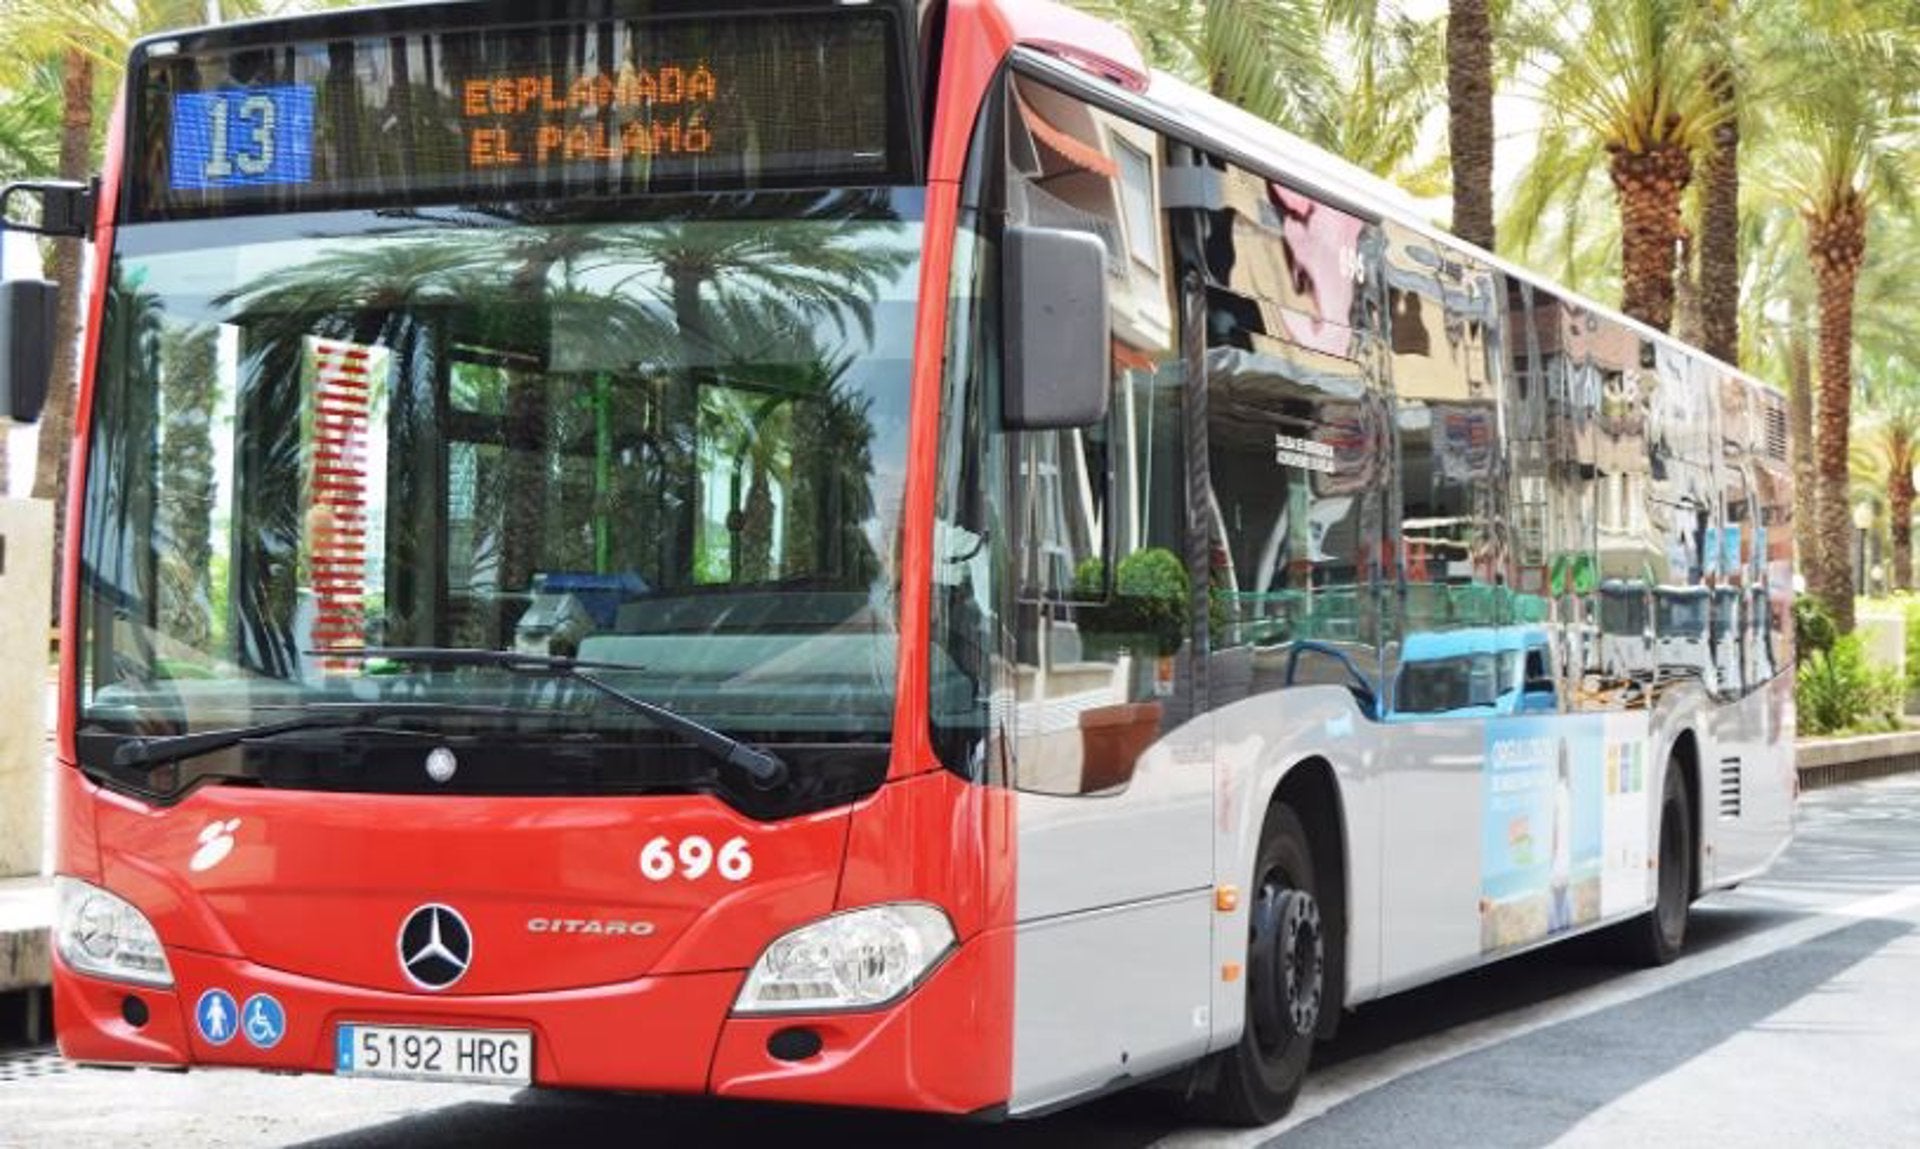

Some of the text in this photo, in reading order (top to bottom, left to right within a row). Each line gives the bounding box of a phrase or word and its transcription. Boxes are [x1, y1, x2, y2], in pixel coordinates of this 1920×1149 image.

[205, 96, 274, 176] 13
[471, 127, 522, 166] EL
[640, 835, 752, 881] 696
[527, 917, 655, 935] CITARO
[363, 1033, 518, 1074] 5192 HRG
